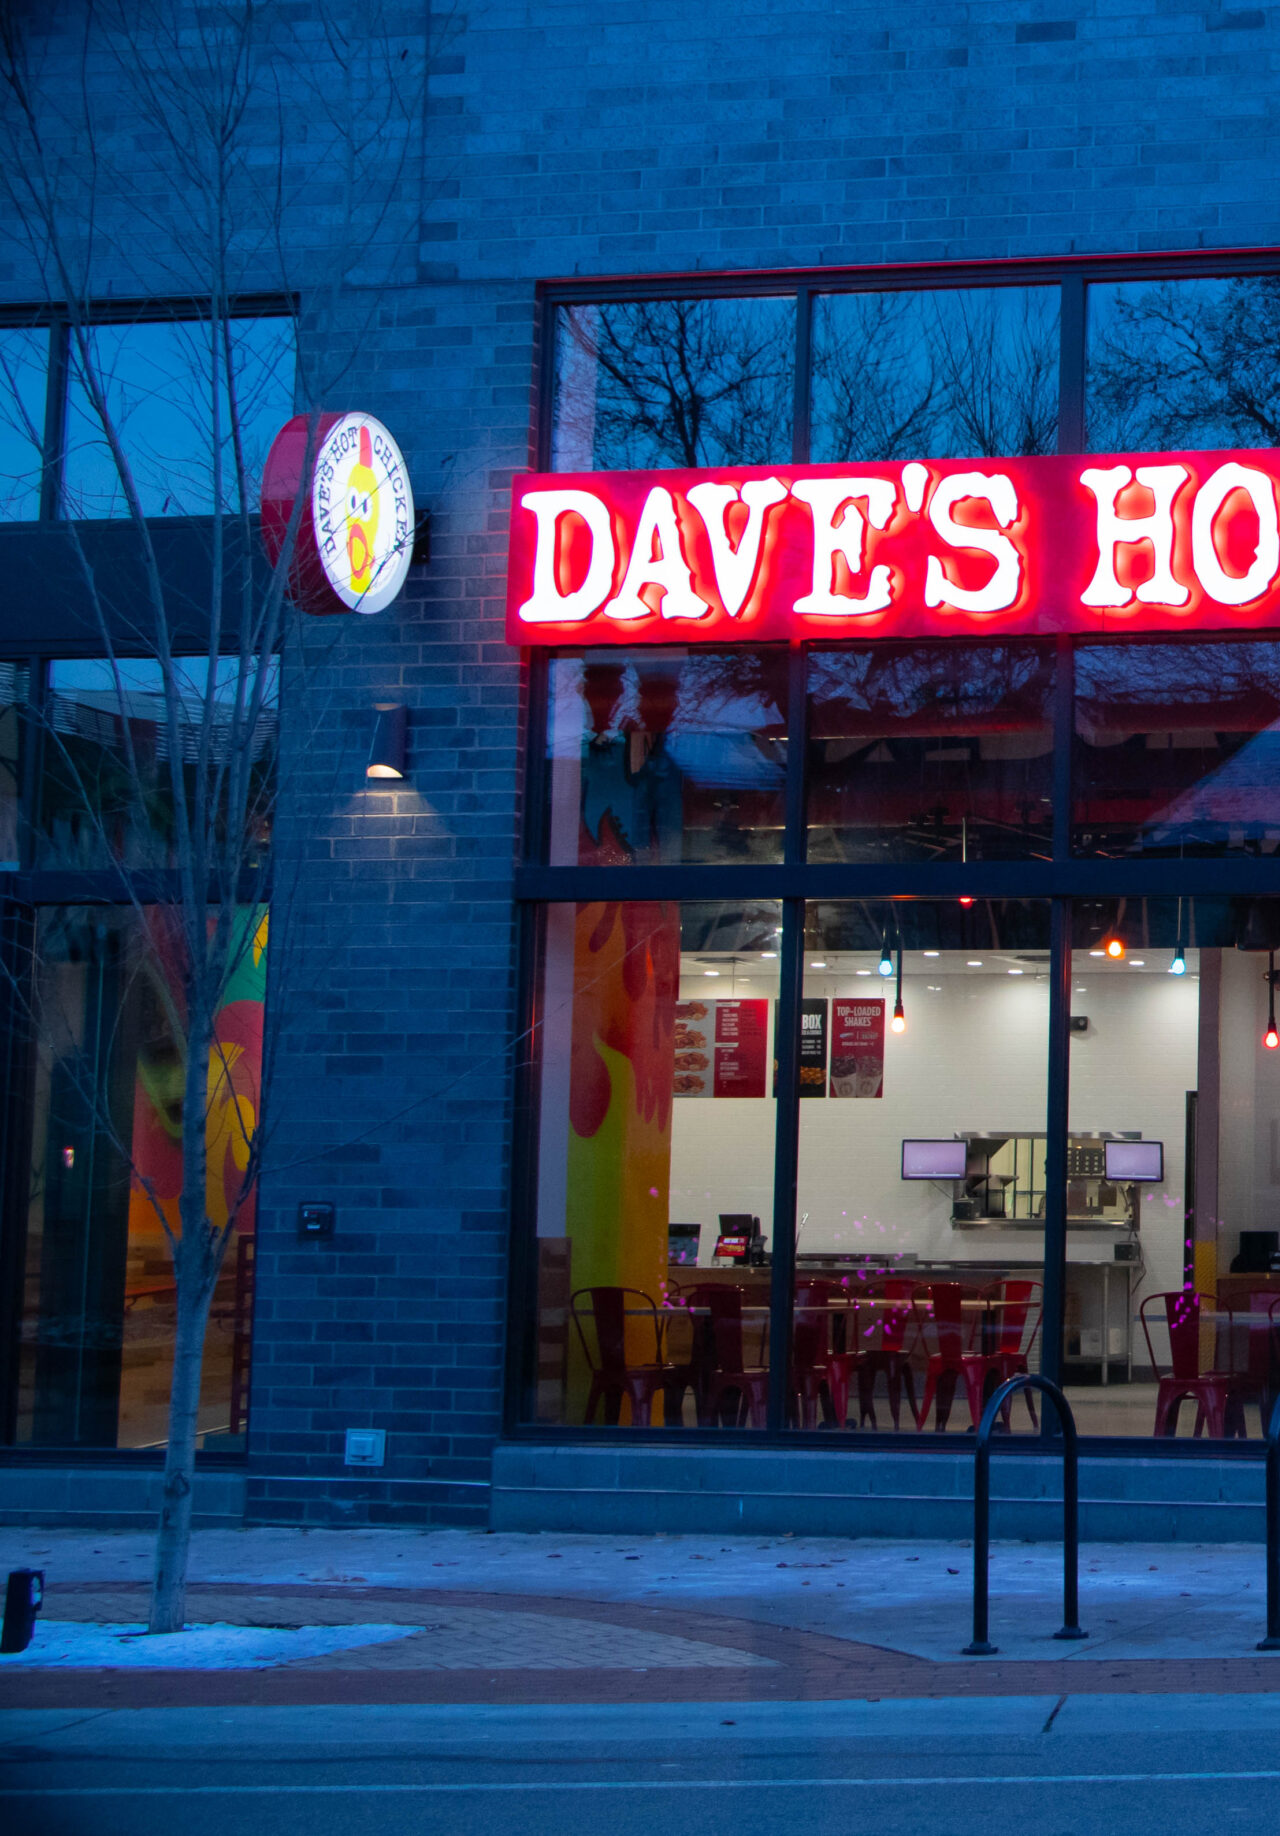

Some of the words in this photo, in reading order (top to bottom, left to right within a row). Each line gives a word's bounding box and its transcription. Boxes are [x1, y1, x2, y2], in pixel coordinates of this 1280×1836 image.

[318, 459, 336, 555] DAVE'S
[329, 425, 358, 464] HOT
[372, 434, 409, 559] CHICKEN
[518, 461, 1021, 623] DAVE'S
[837, 1006, 881, 1016] TOP-LOADED
[801, 1014, 822, 1030] BOX
[844, 1017, 872, 1026] SHAKES
